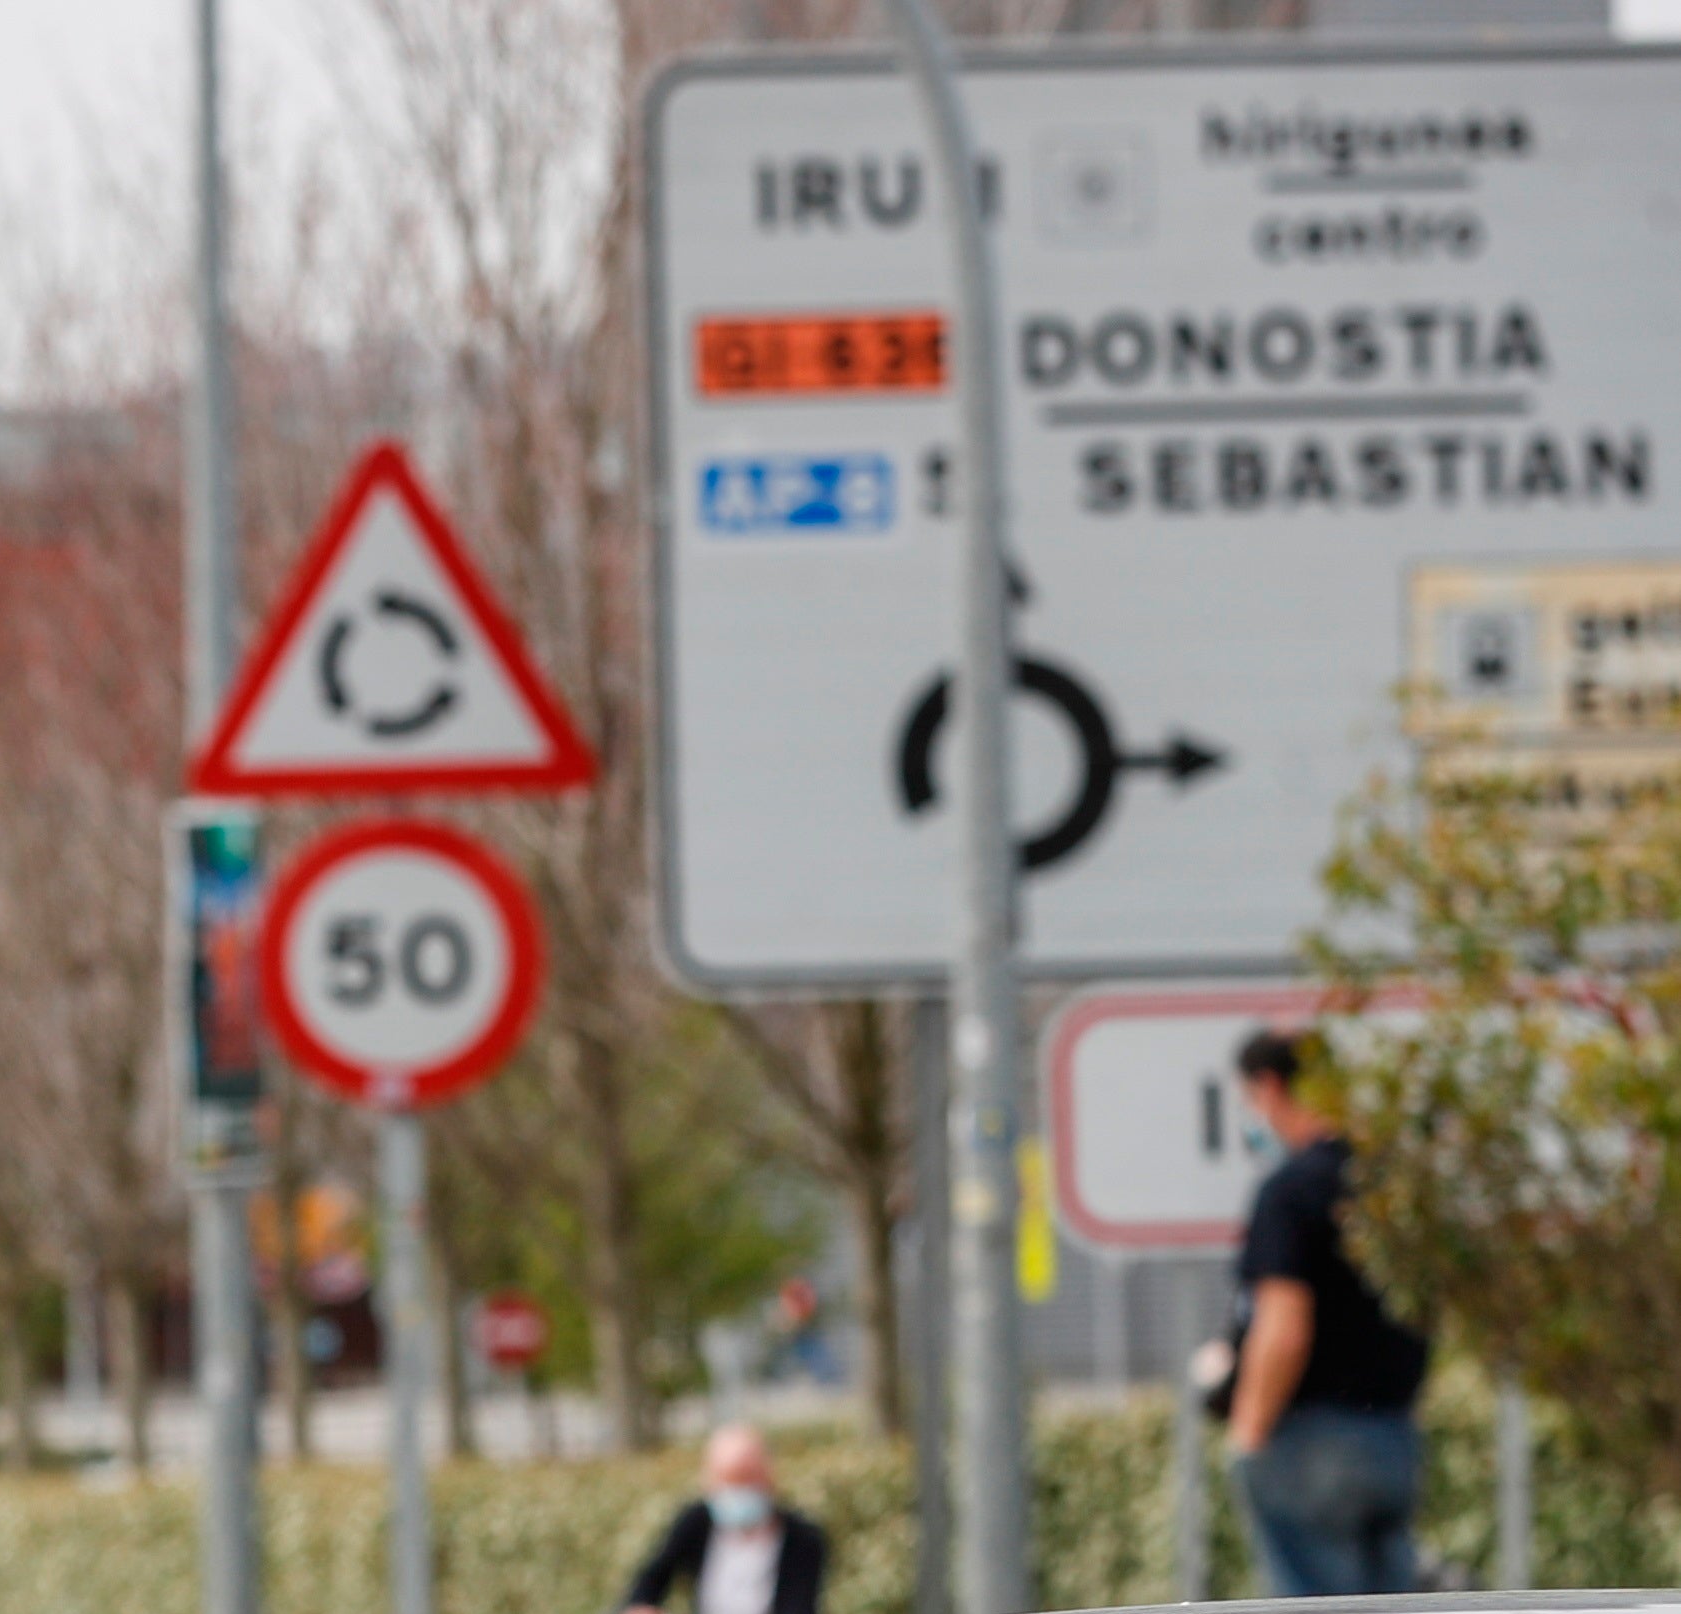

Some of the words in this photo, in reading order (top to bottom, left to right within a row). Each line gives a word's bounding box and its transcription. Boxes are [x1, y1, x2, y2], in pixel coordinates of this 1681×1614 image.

[1022, 305, 1549, 390] DONOSTIA
[1079, 432, 1652, 516] SEBASTIAN
[325, 913, 474, 1006] 50
